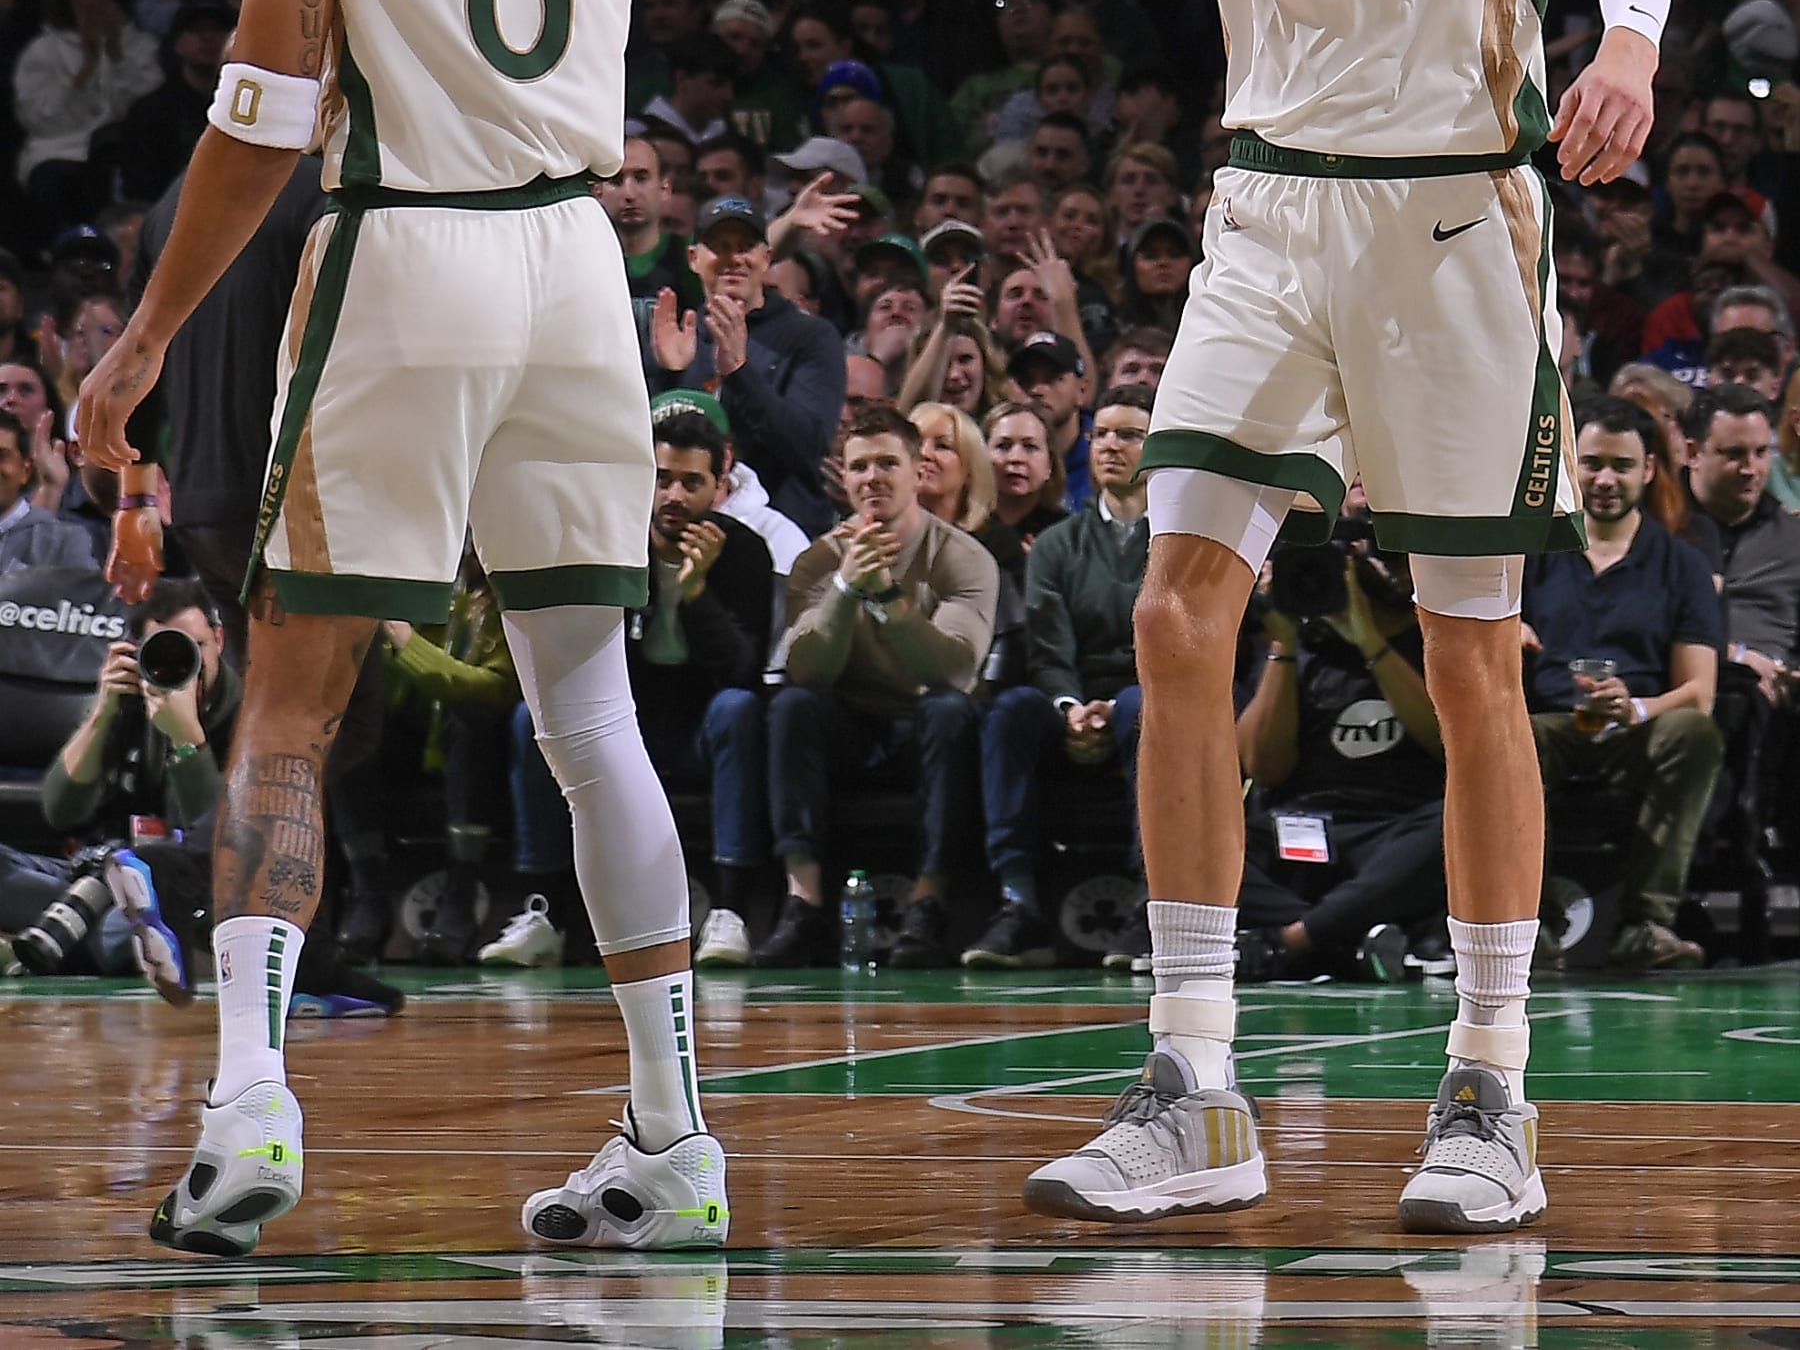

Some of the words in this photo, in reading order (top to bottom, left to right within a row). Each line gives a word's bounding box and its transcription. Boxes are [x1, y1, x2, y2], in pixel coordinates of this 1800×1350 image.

[230, 79, 263, 126] 0
[1524, 414, 1556, 507] CELTICS
[0, 599, 125, 638] @celtics
